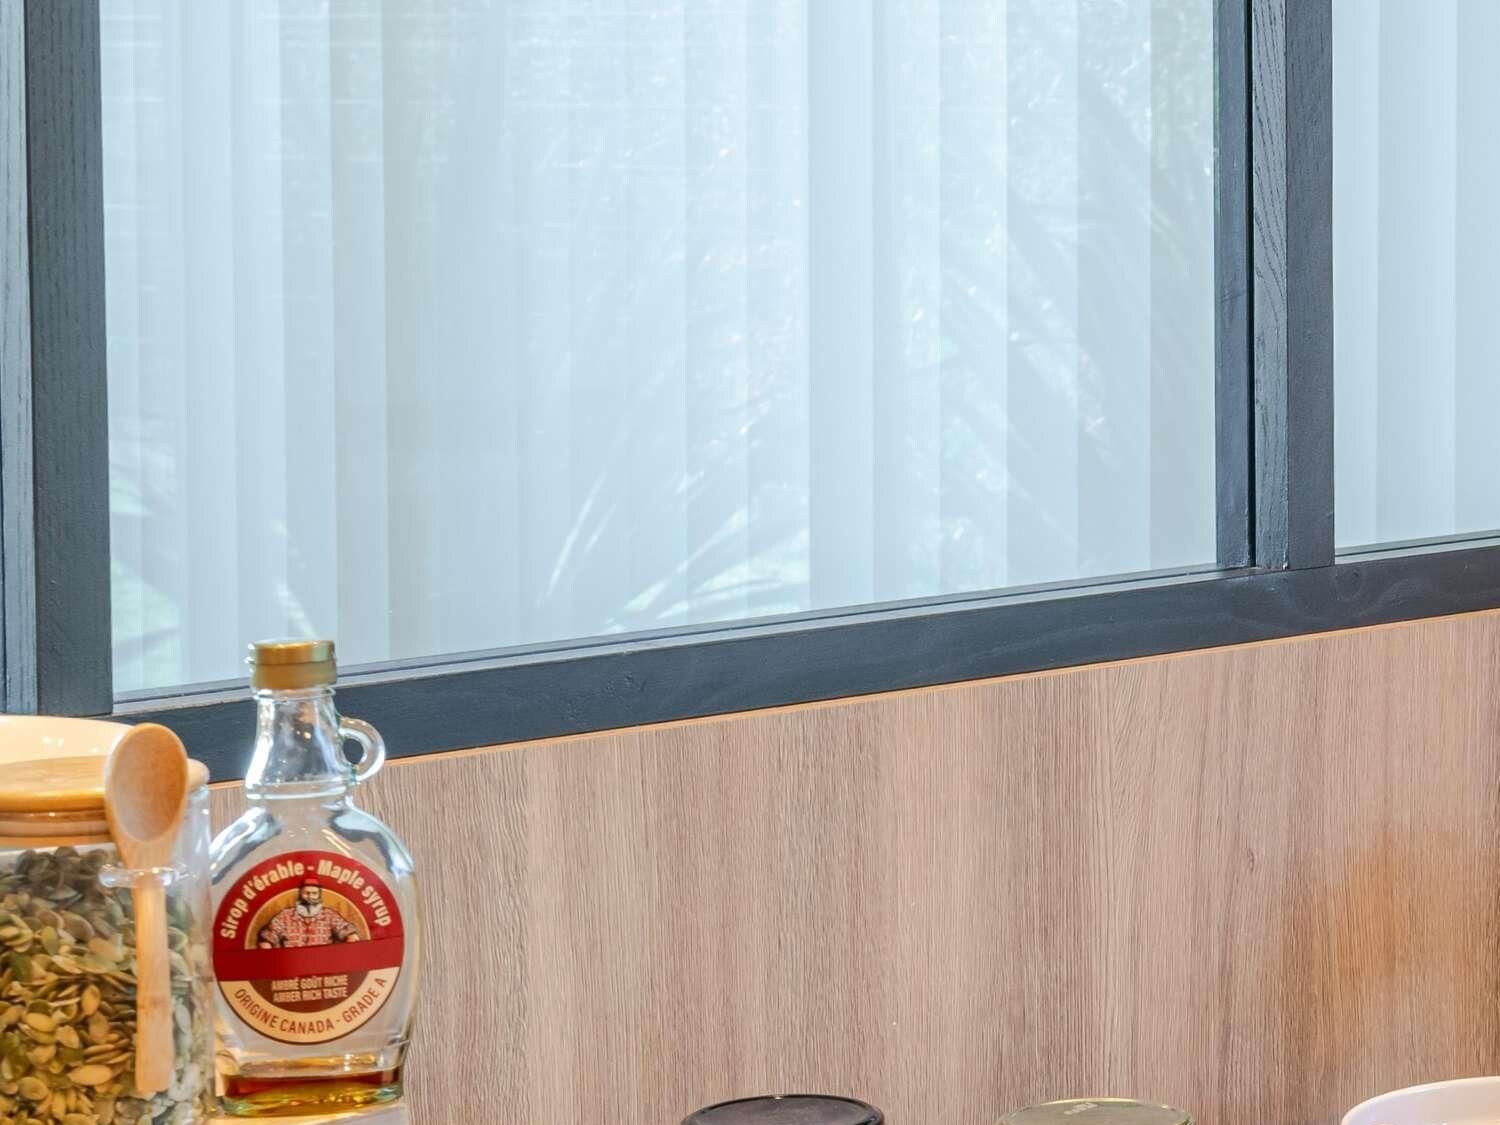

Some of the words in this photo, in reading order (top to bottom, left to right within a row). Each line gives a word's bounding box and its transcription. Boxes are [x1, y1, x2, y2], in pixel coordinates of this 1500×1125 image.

[221, 898, 249, 939] Sirop
[242, 860, 305, 900] d'érable
[317, 859, 366, 890] Maple
[361, 885, 392, 926] syrup
[234, 988, 279, 1028] ORIGINE
[279, 1018, 335, 1034] CANADA
[342, 987, 380, 1024] GRADE
[374, 977, 387, 988] A
[323, 986, 348, 1000] TASTE
